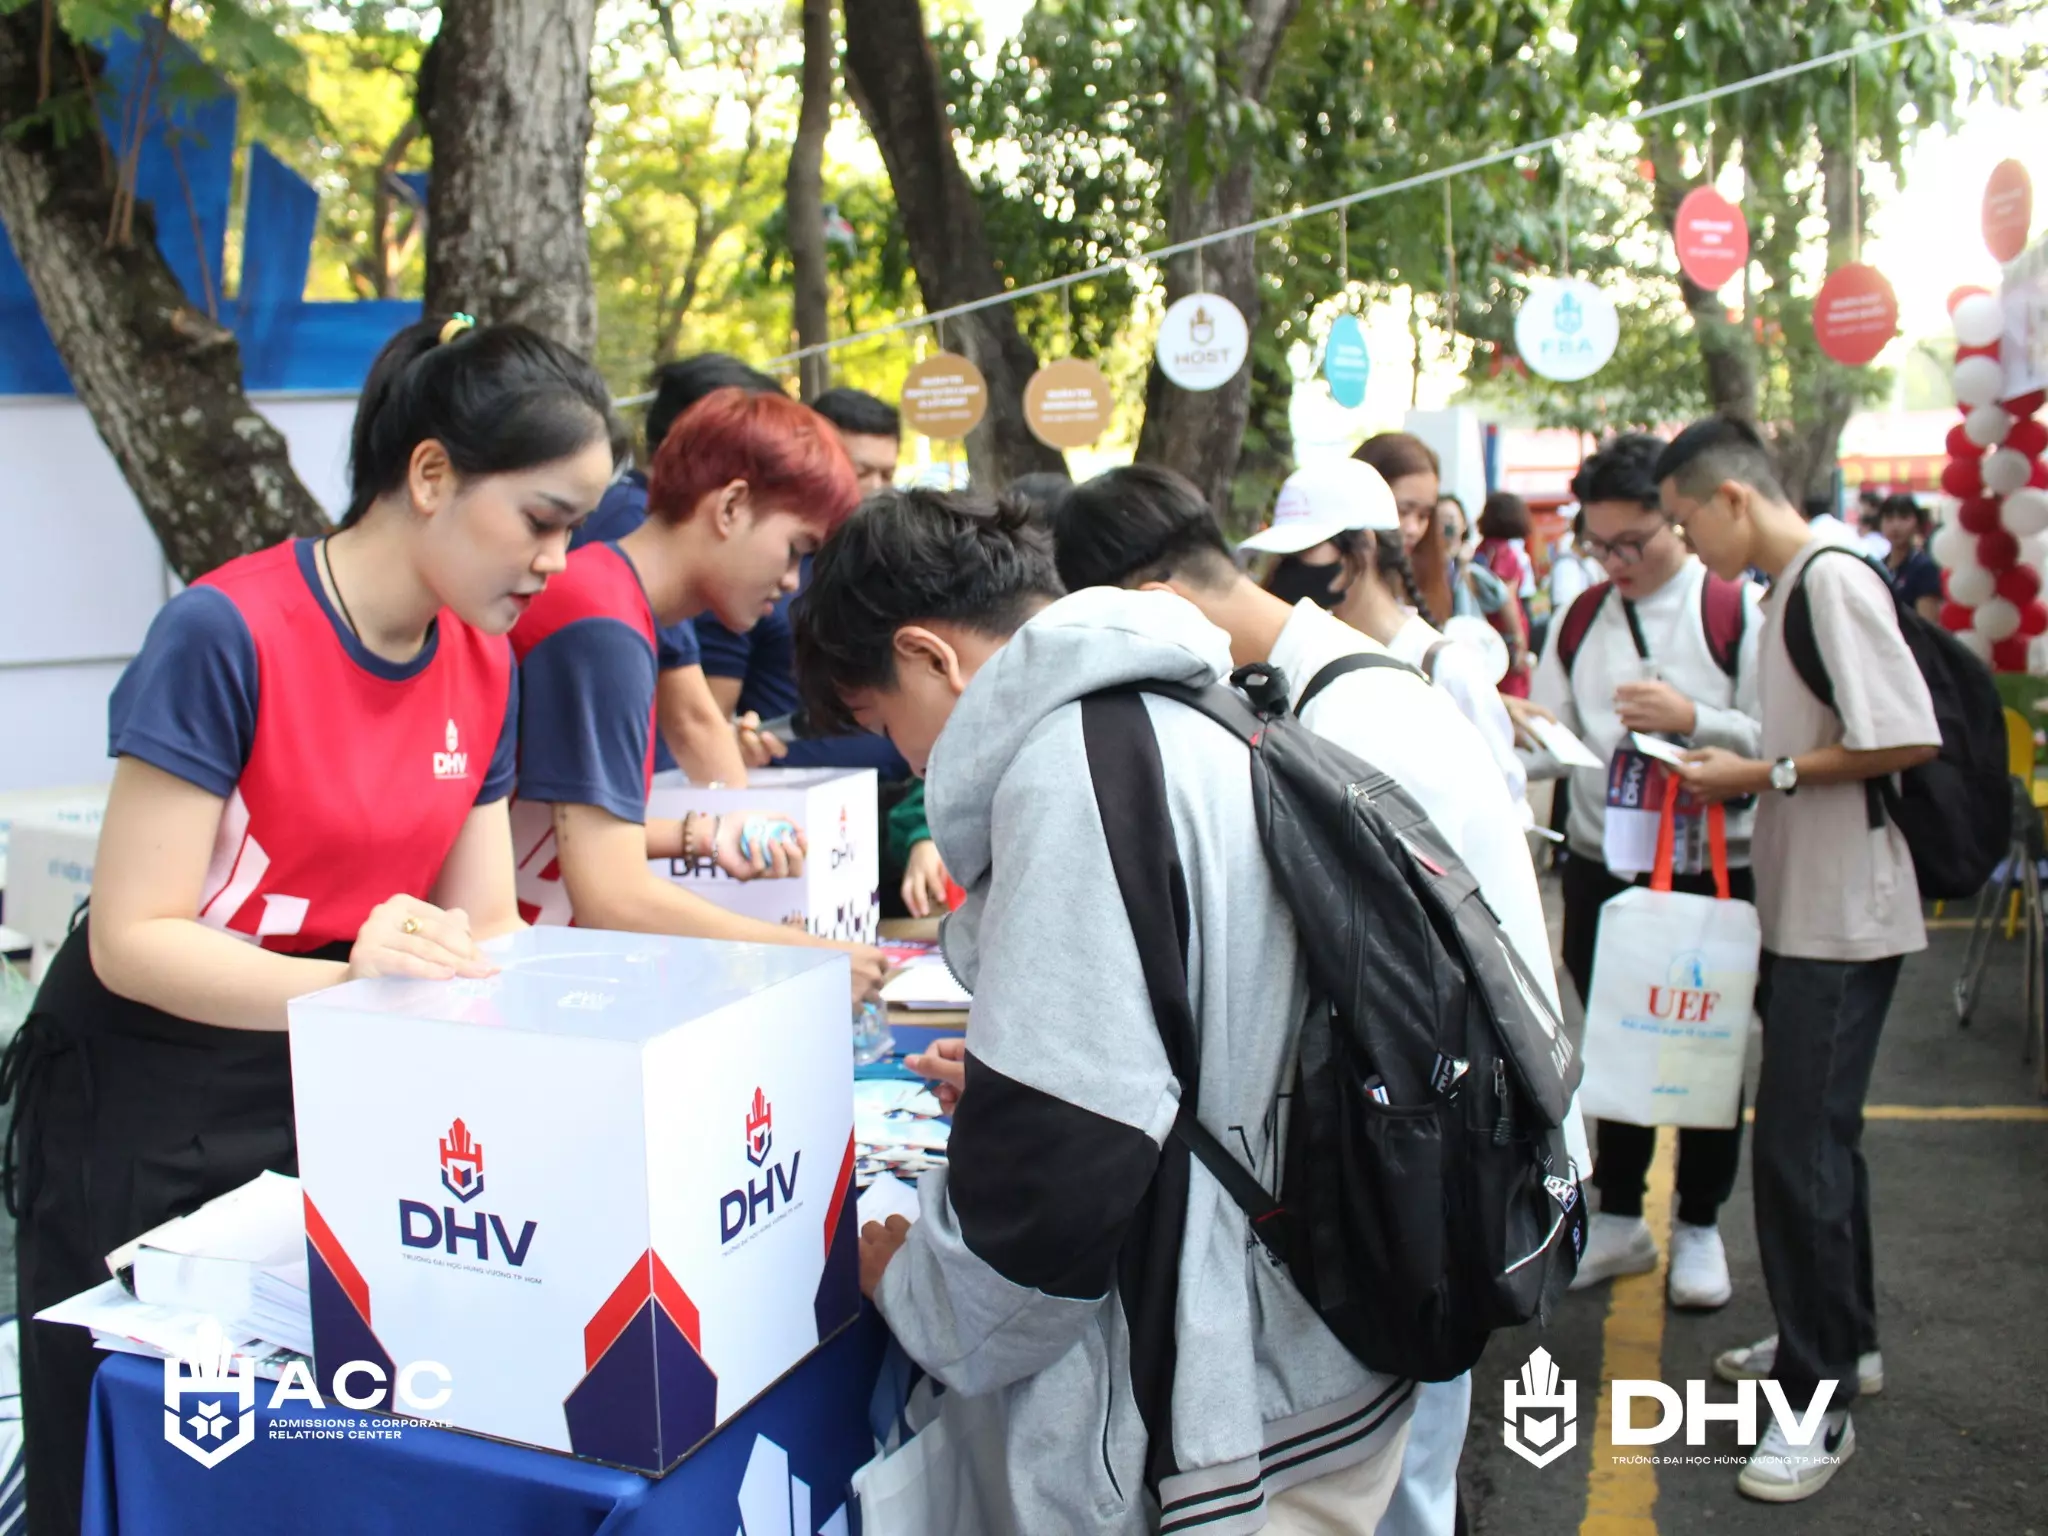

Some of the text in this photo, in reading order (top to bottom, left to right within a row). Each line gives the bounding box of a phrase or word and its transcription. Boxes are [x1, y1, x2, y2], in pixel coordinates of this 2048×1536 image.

[1174, 348, 1230, 366] HOST
[433, 751, 468, 774] DHV
[1647, 985, 1721, 1023] UEF
[720, 1149, 801, 1245] DHV
[399, 1198, 538, 1267] DHV
